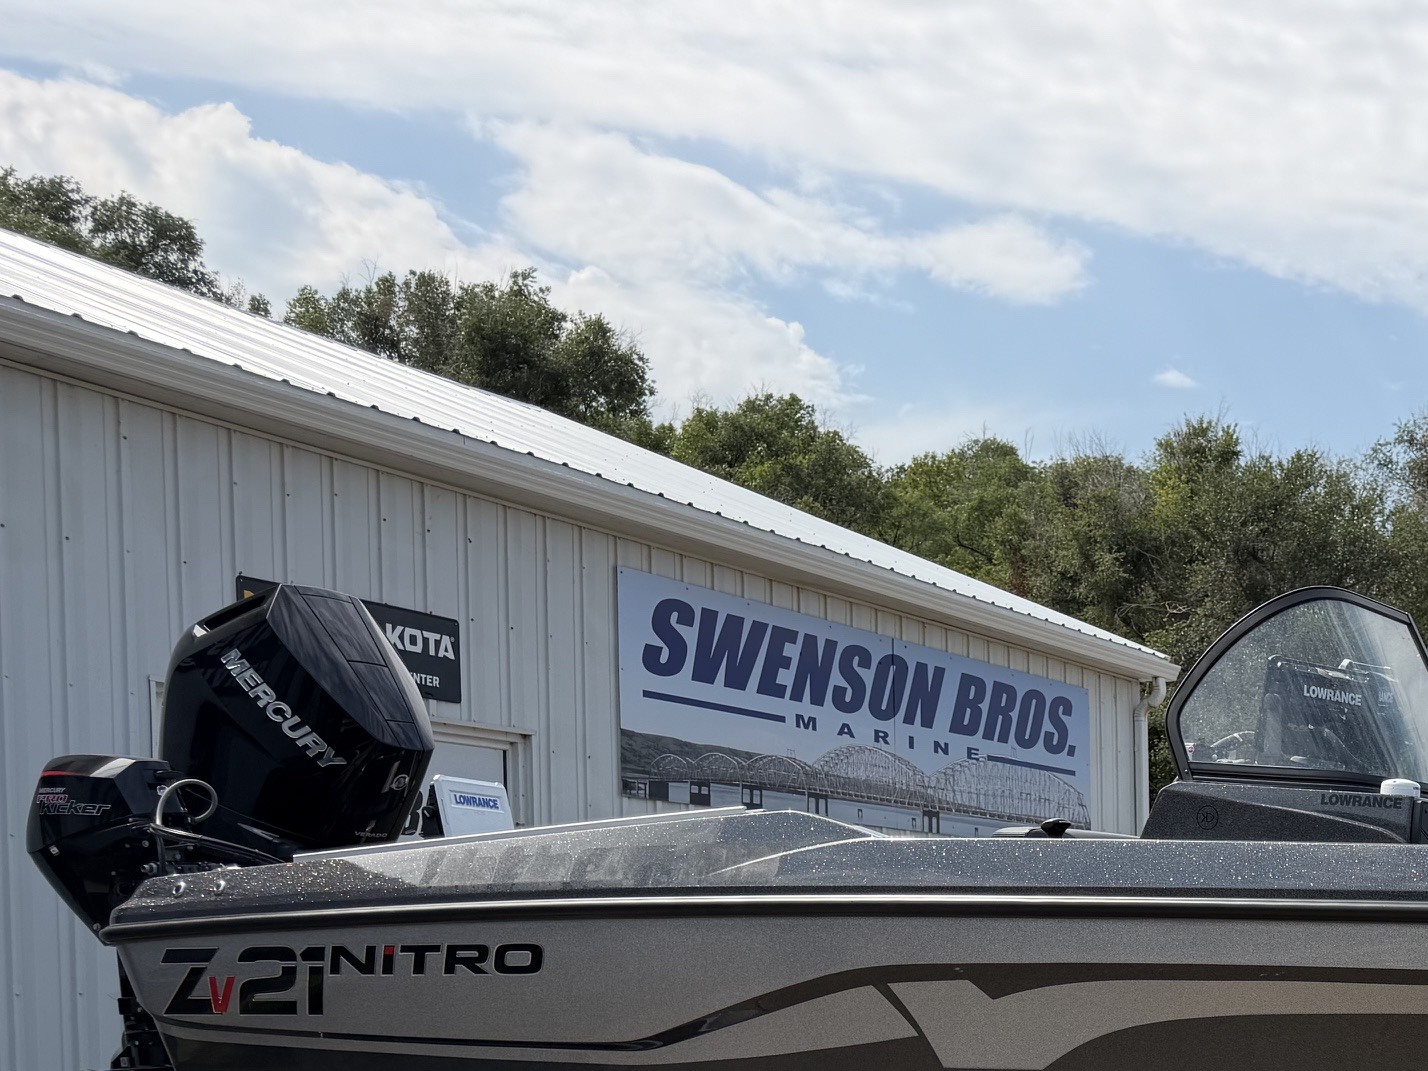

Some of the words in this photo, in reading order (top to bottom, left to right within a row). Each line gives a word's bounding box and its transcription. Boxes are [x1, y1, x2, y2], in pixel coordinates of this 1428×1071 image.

[411, 671, 440, 688] NTER
[641, 598, 946, 729] SWENSON
[948, 672, 1077, 758] BROS.
[1304, 684, 1362, 706] LOWRANCE
[220, 648, 347, 767] MERCURY
[795, 713, 981, 761] MARINE
[453, 793, 500, 810] LOWRANCE
[1320, 793, 1403, 810] LOWRANCE
